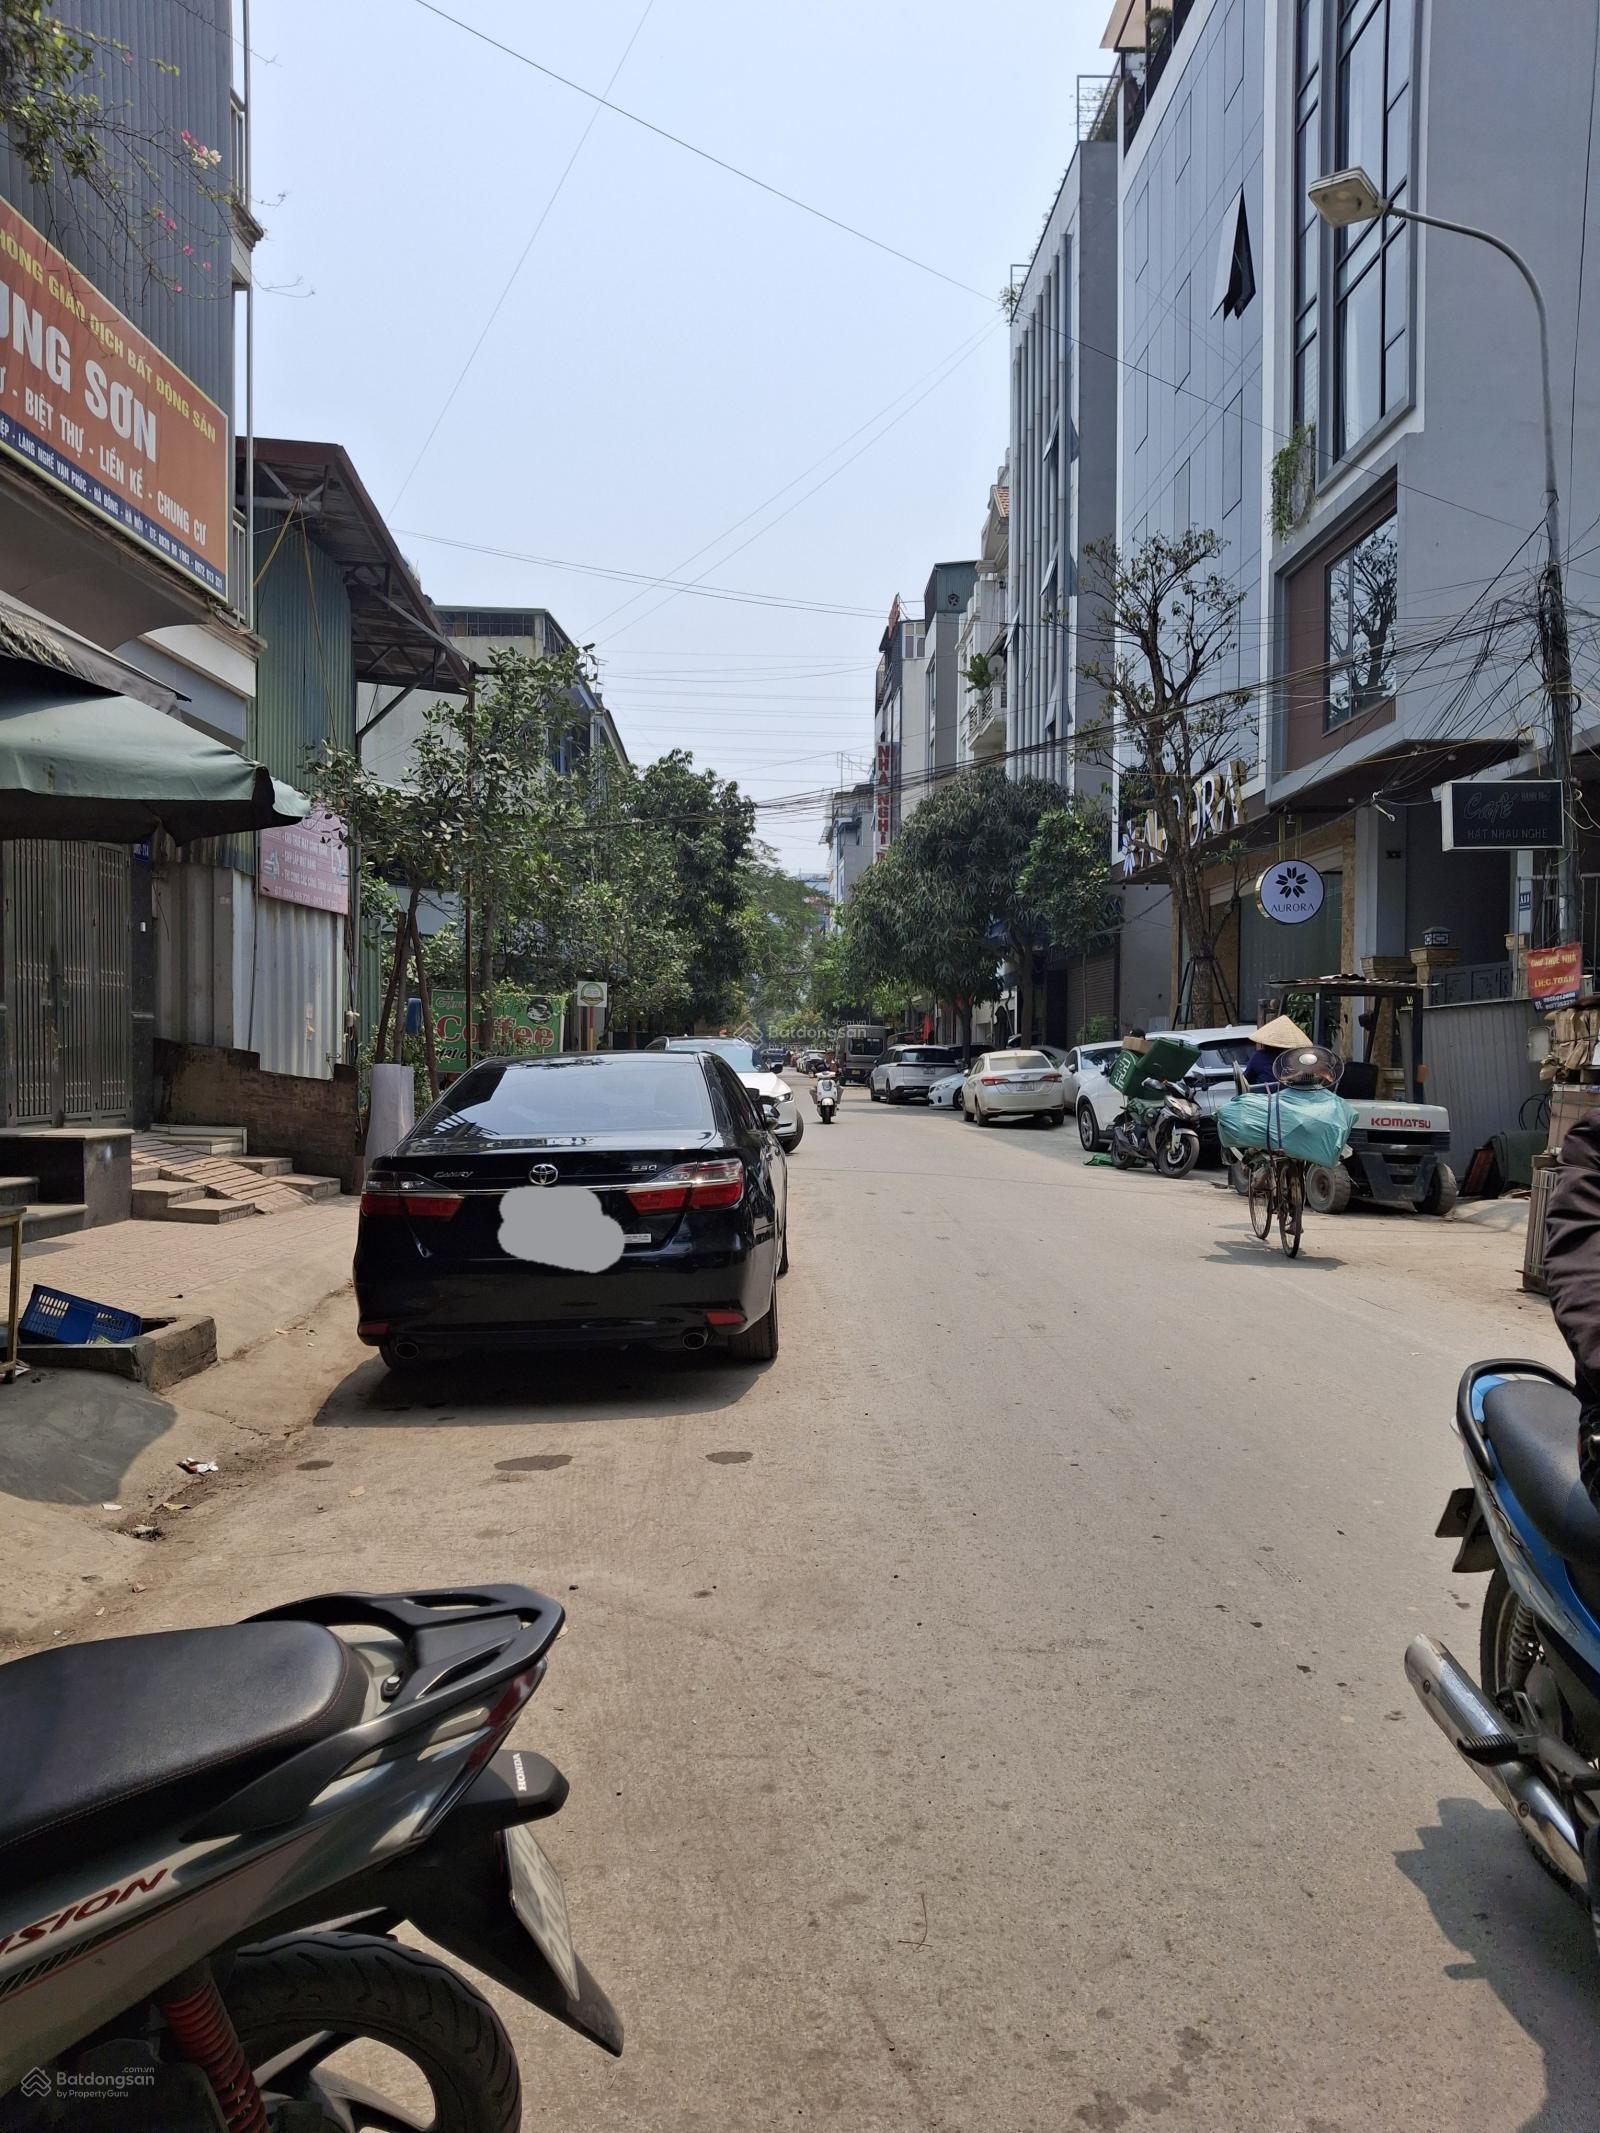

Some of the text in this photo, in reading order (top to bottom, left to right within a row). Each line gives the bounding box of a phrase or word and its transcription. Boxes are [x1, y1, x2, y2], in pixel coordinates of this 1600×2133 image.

[84, 360, 157, 462] SƠN
[90, 311, 124, 358] DỊCH
[127, 347, 153, 384] BẤT
[156, 375, 189, 420] ĐỘNG
[192, 410, 216, 443] SẢN
[25, 386, 54, 432] BIỆT
[60, 414, 84, 458] THỰ
[157, 490, 190, 535] CHUNG
[193, 519, 207, 546] CƯ
[1271, 902, 1315, 913] AURORA
[1371, 1117, 1431, 1129] KOMATSU
[512, 1753, 527, 1792] HONDA
